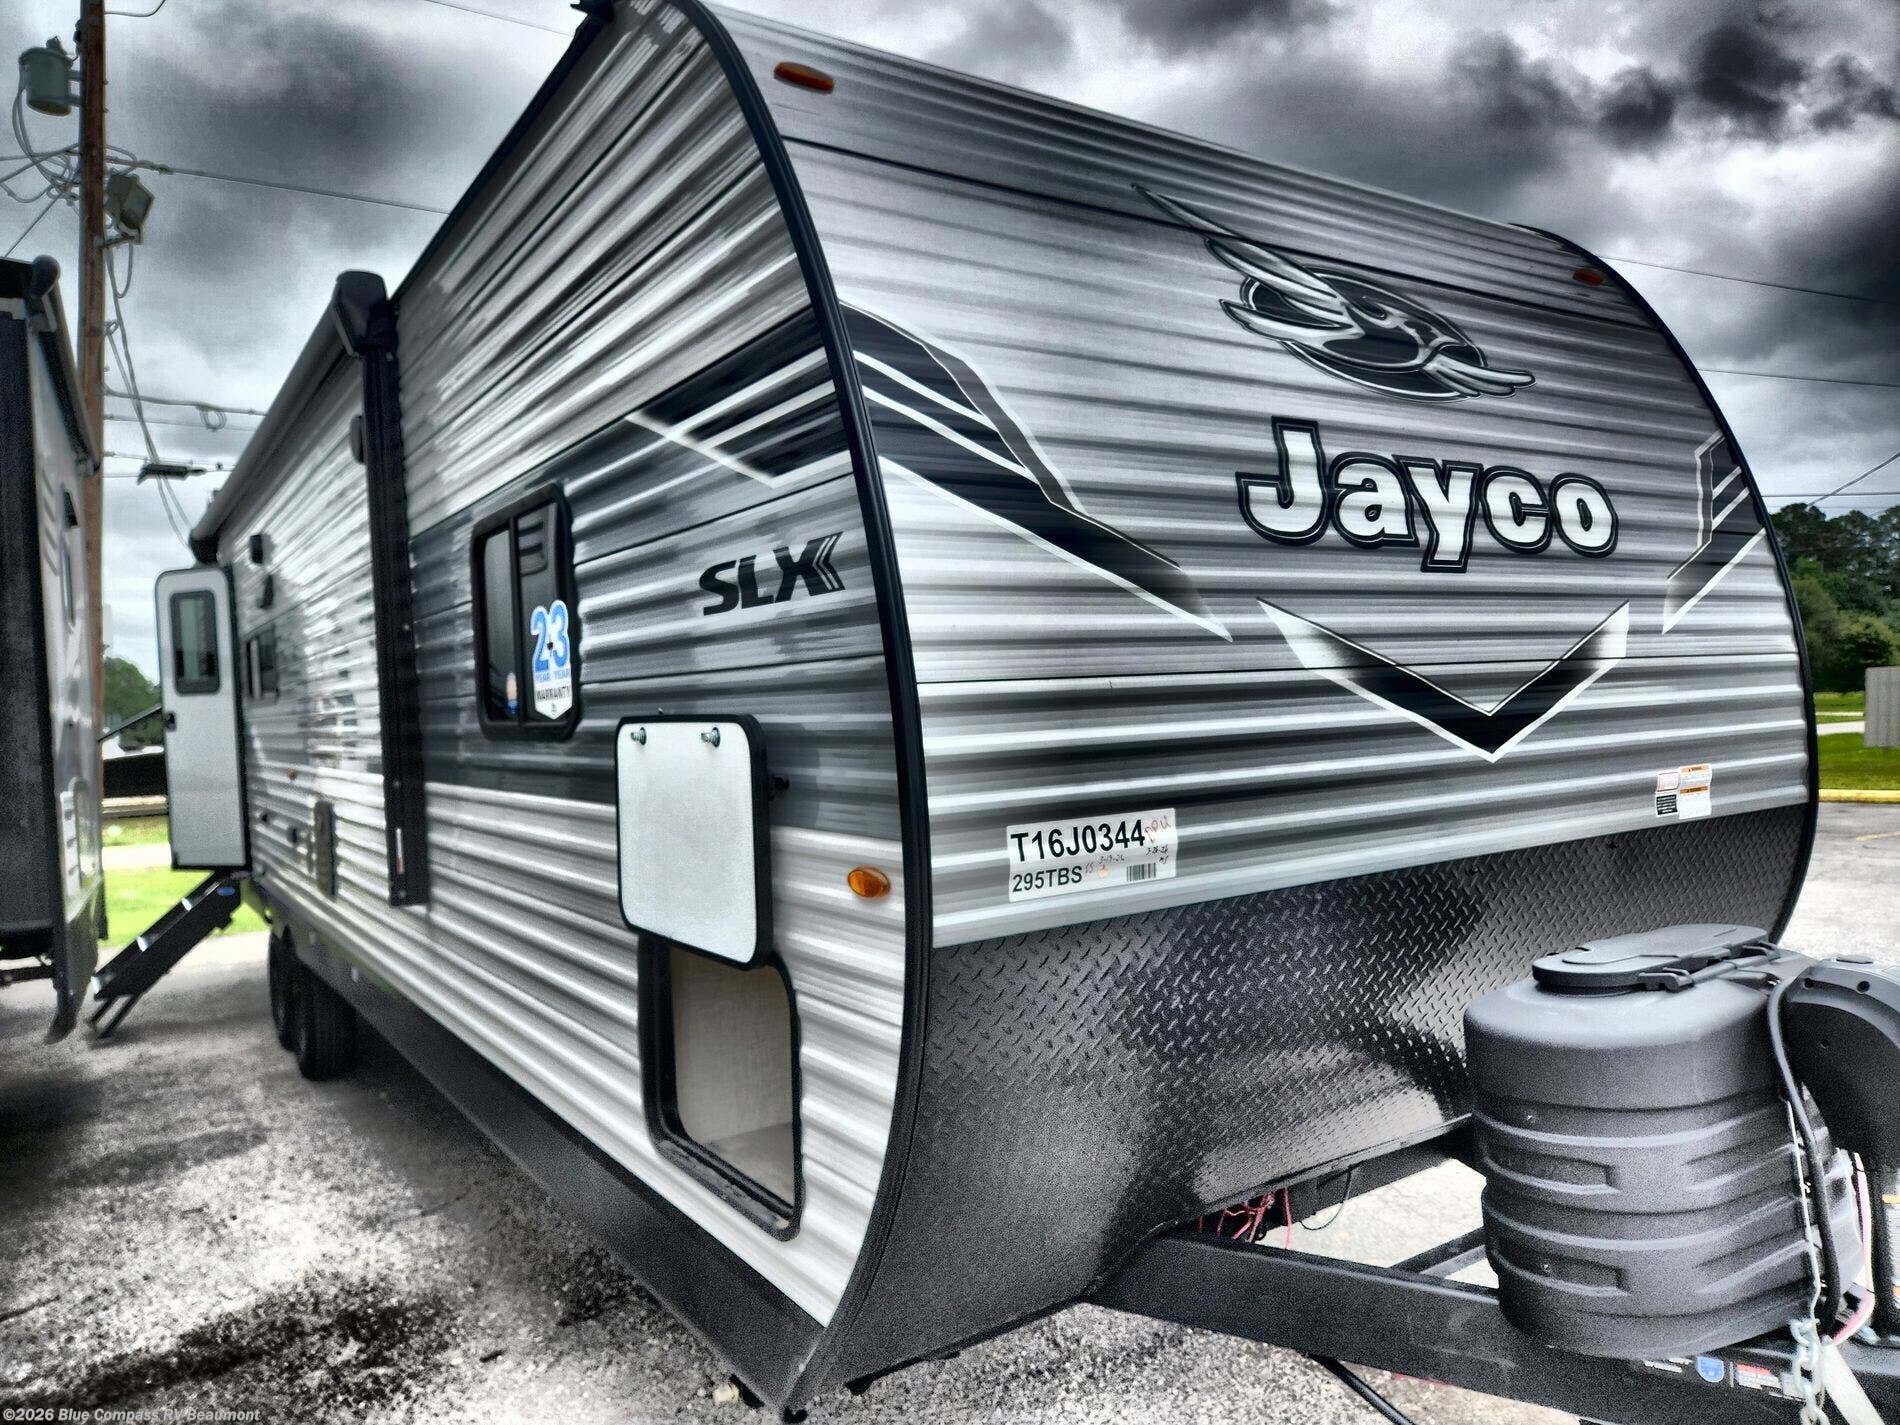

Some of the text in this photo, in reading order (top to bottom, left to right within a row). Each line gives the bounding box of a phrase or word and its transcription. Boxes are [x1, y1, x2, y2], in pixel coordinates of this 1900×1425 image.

[1235, 415, 1618, 573] Jayco
[699, 531, 845, 616] SLX
[1010, 819, 1145, 862] T16J0344
[1012, 865, 1083, 892] 295TBS
